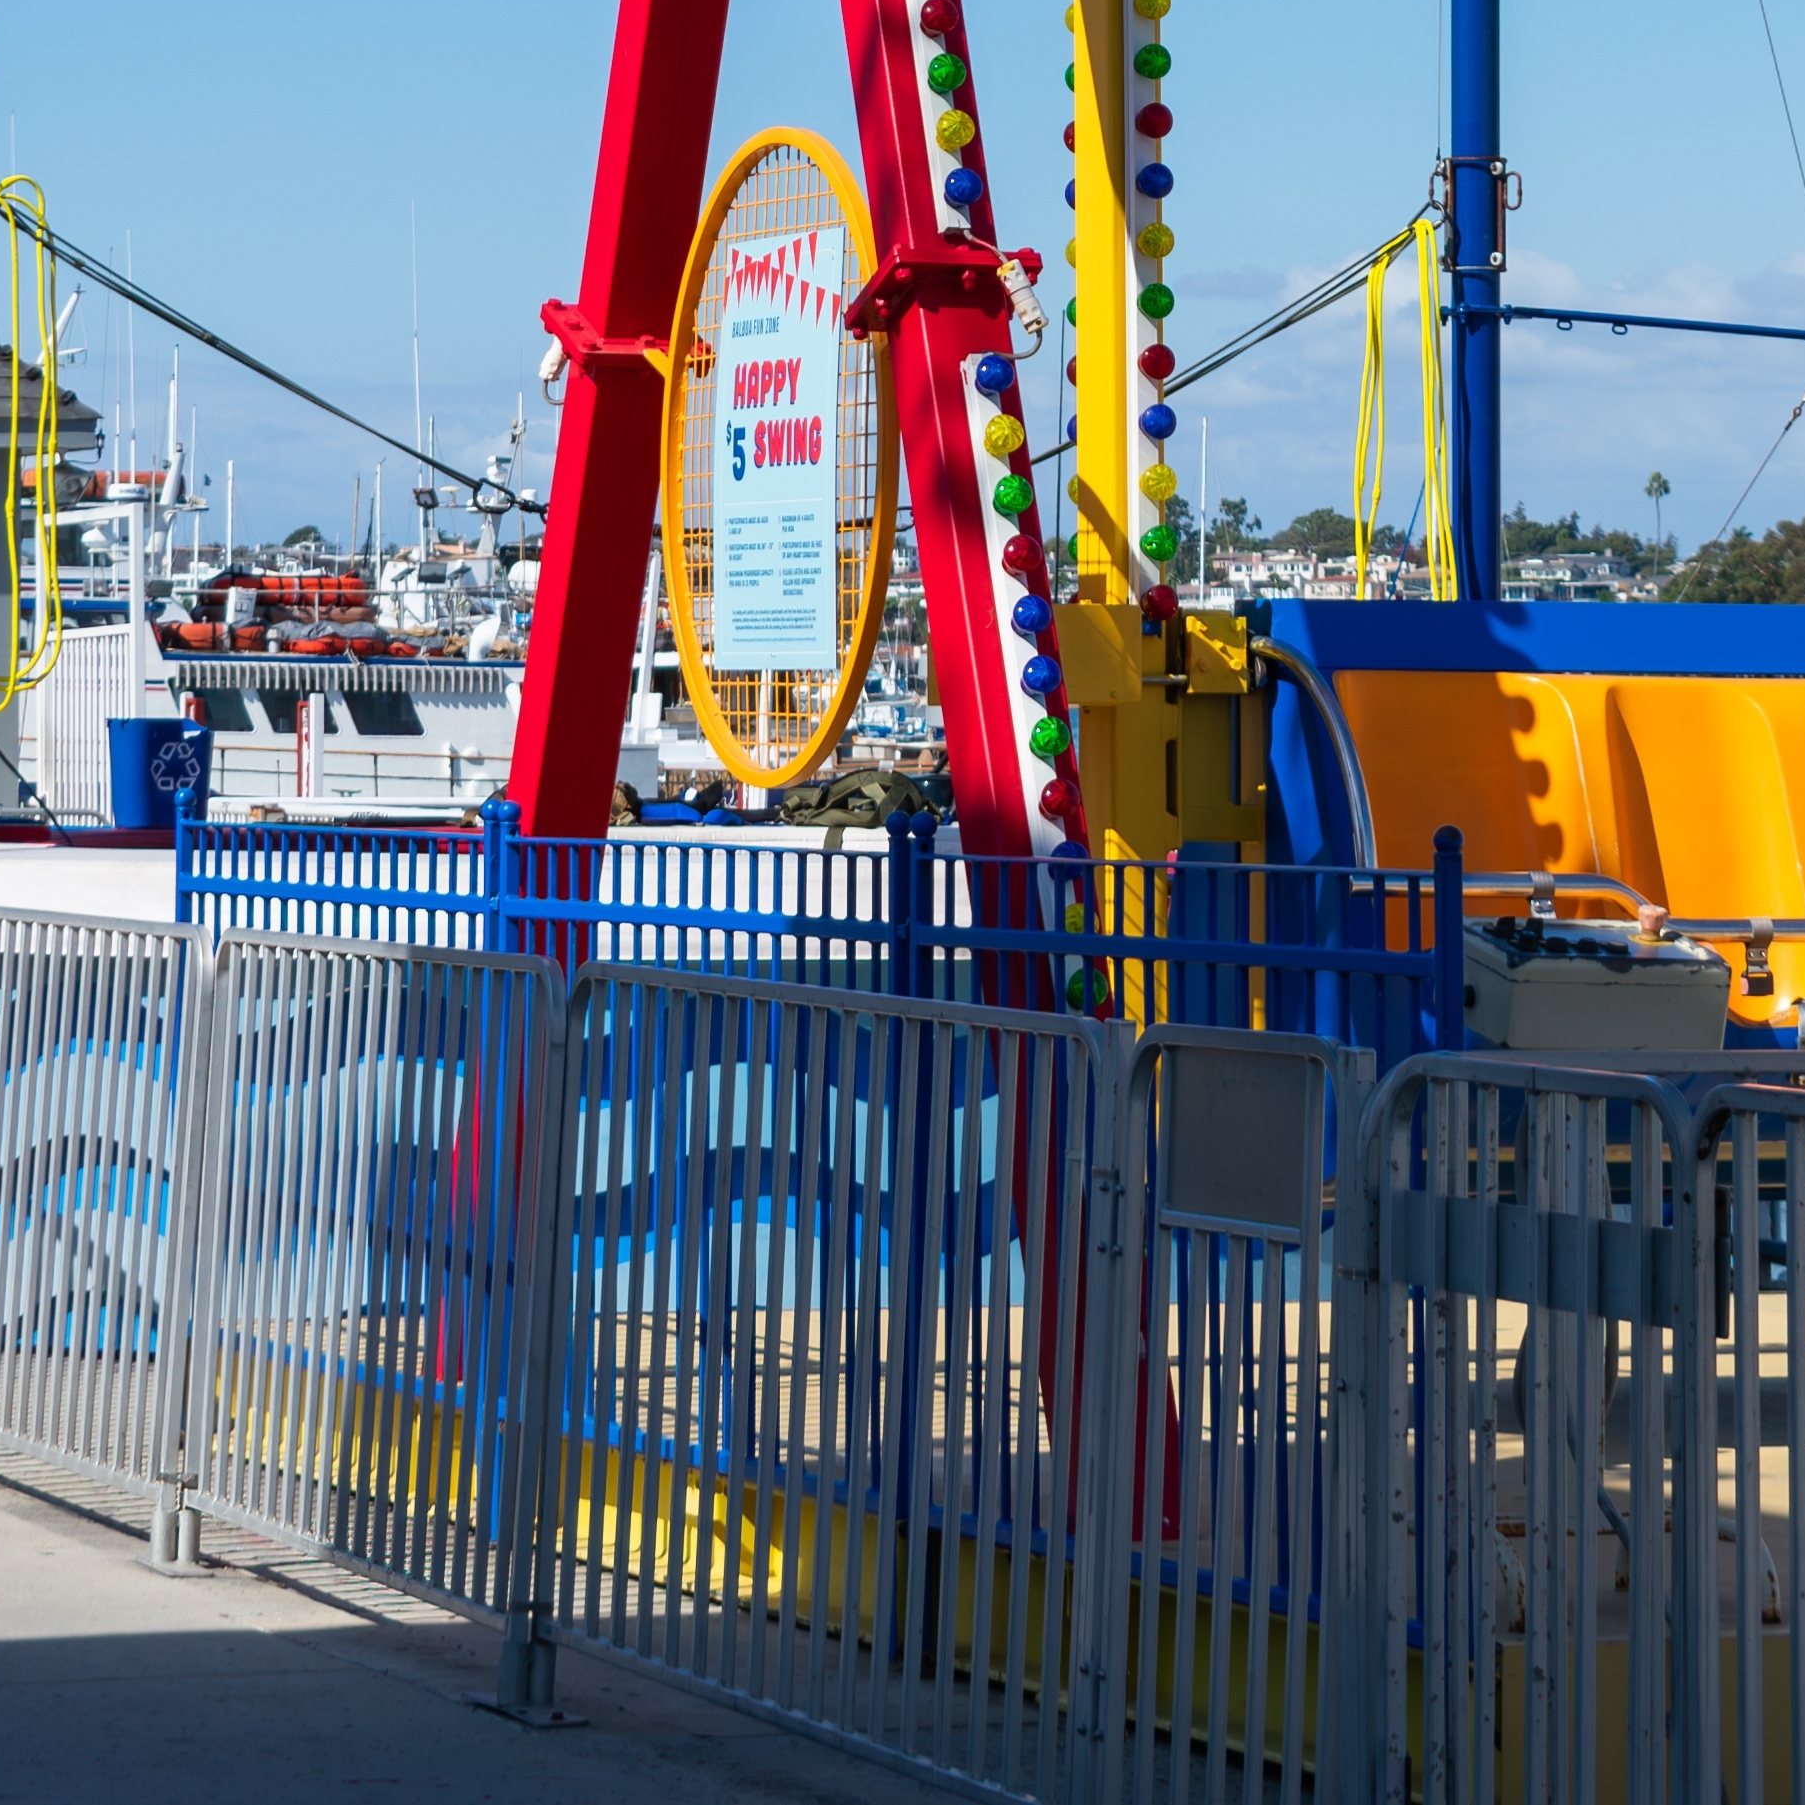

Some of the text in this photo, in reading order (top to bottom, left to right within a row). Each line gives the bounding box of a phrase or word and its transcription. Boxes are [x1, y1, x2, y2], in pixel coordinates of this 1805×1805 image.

[732, 316, 780, 338] BALBOA FUN ZONE
[733, 357, 801, 410] HAPPY
[726, 415, 823, 482] $5 SWING
